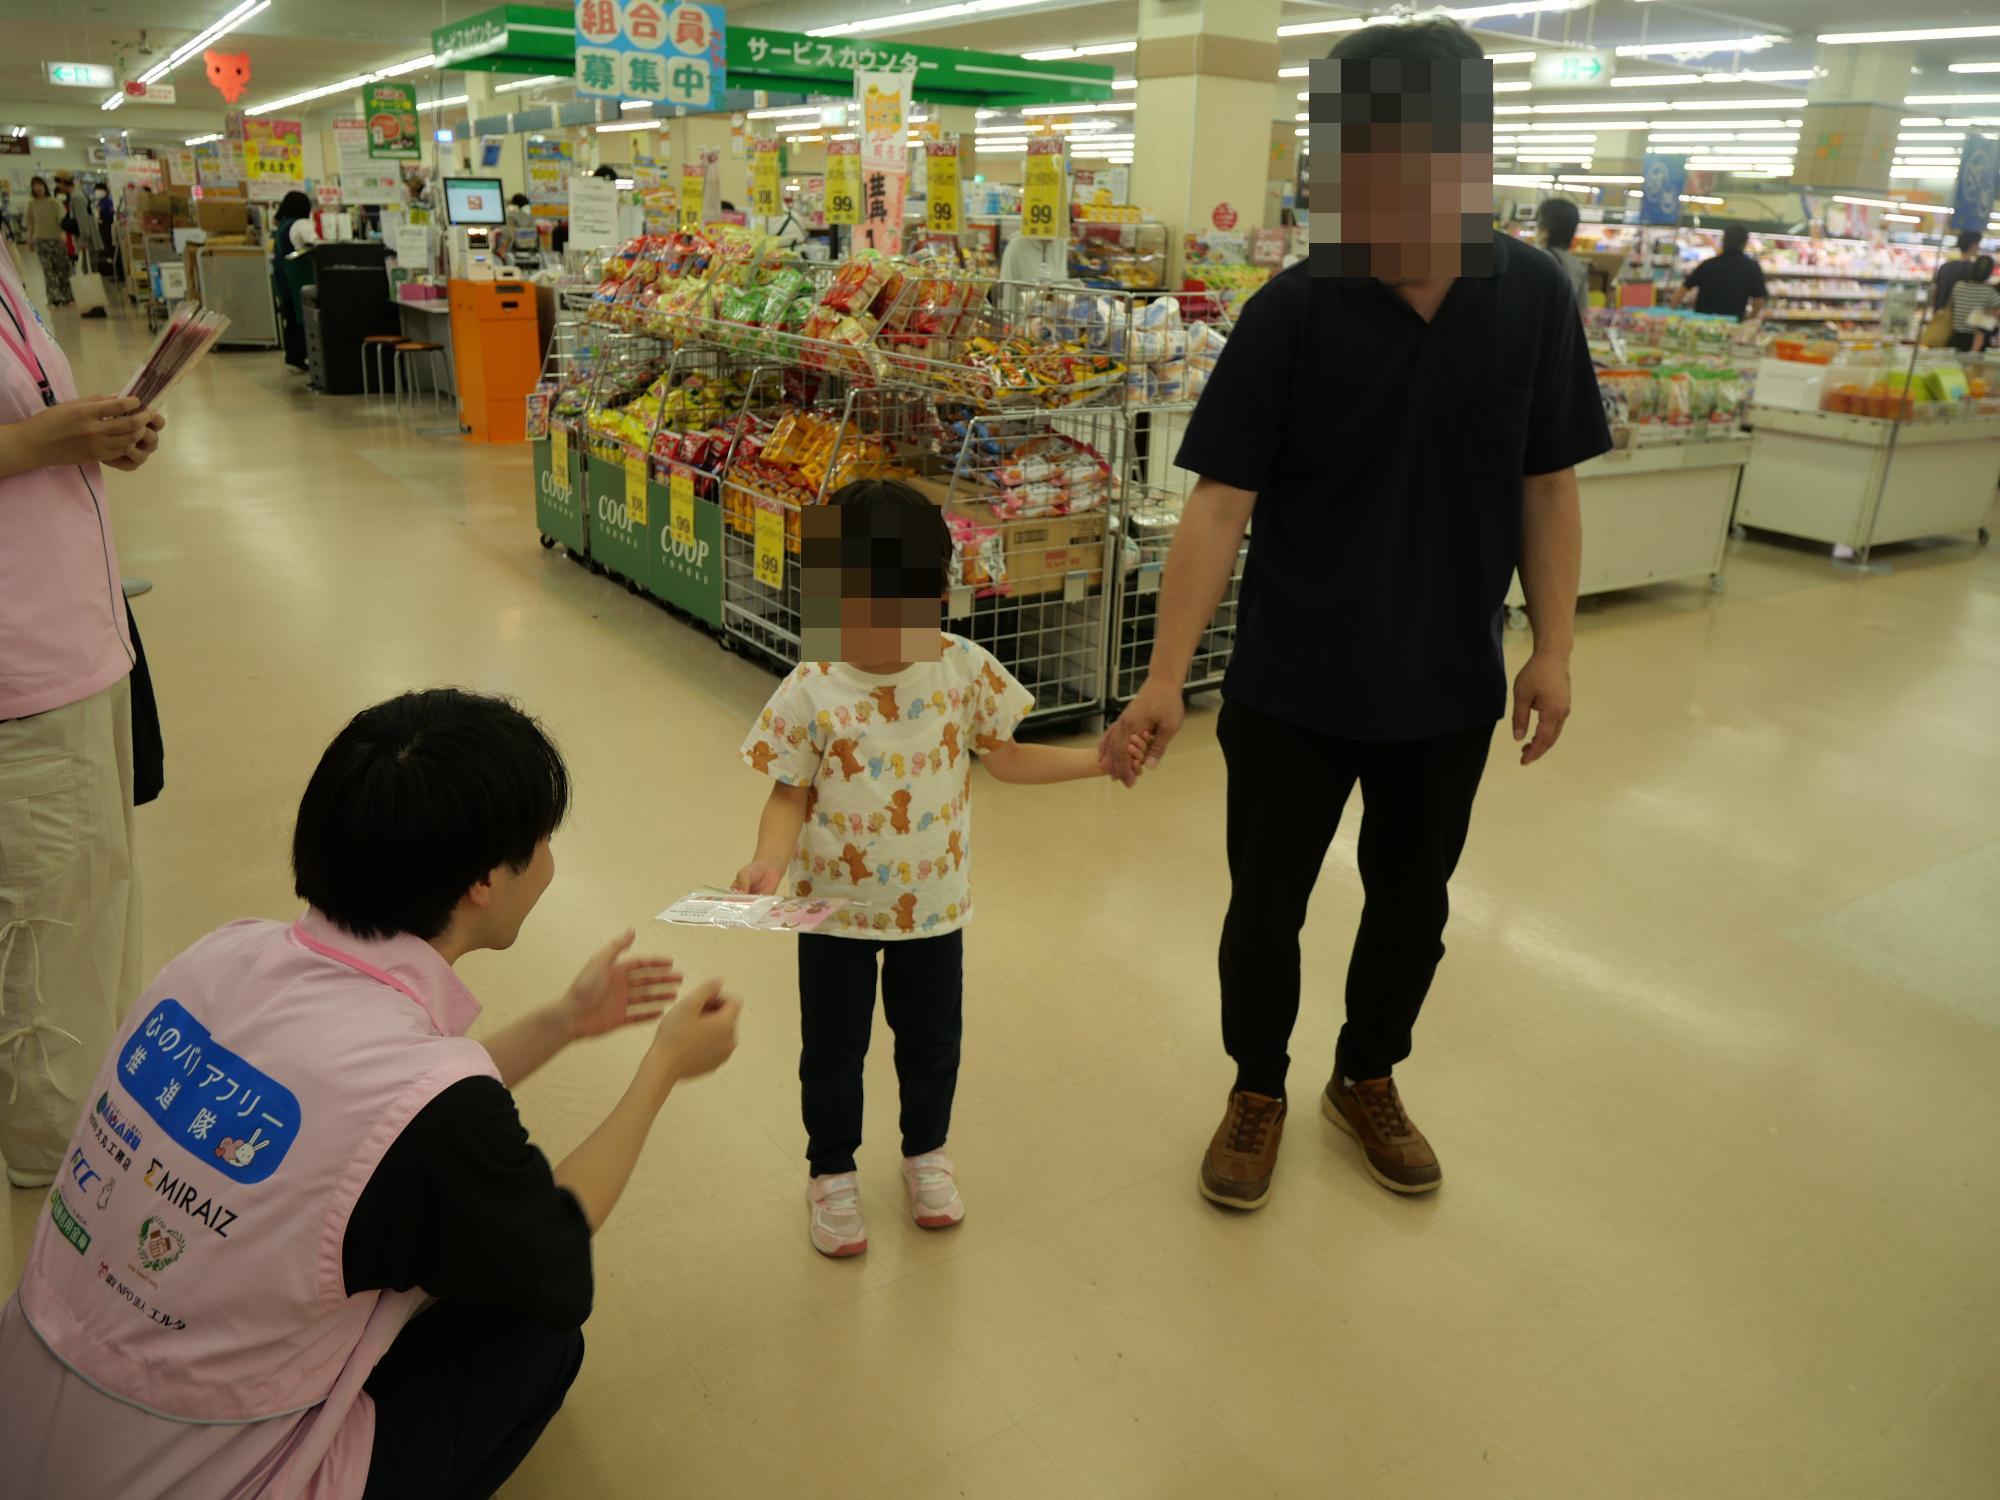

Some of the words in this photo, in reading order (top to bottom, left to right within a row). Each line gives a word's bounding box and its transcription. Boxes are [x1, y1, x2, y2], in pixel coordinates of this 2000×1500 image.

[581, 0, 705, 48] 組合員
[747, 36, 939, 72] サービスカウンター
[582, 53, 704, 98] 募集中
[832, 195, 853, 212] 99
[933, 202, 952, 221] 99
[1030, 204, 1052, 224] 99
[675, 515, 691, 534] 99
[660, 524, 710, 569] COOP
[761, 553, 778, 574] 99
[155, 1170, 239, 1239] MIRAIZ
